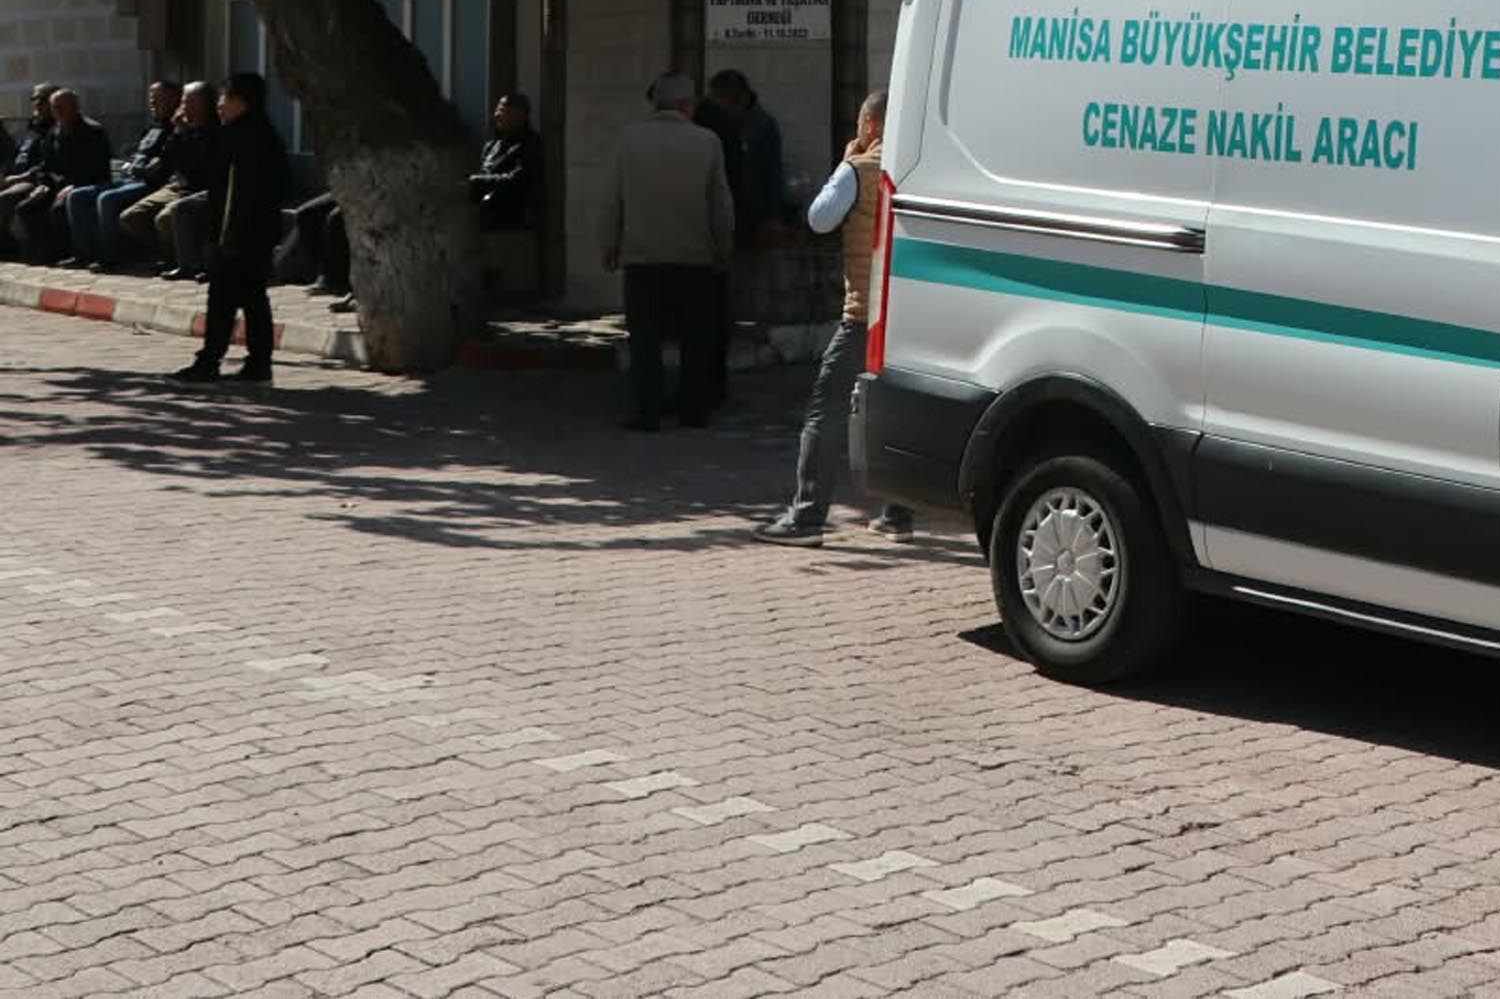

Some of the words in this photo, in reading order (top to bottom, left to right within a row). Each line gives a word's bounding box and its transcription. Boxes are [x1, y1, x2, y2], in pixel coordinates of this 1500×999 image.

[1008, 8, 1112, 63] MANİSA
[1120, 12, 1321, 81] BÜYÜKŞEHİR
[1082, 102, 1196, 155] CENAZE
[1205, 102, 1302, 163] NAKİL
[1312, 117, 1419, 171] ARACI
